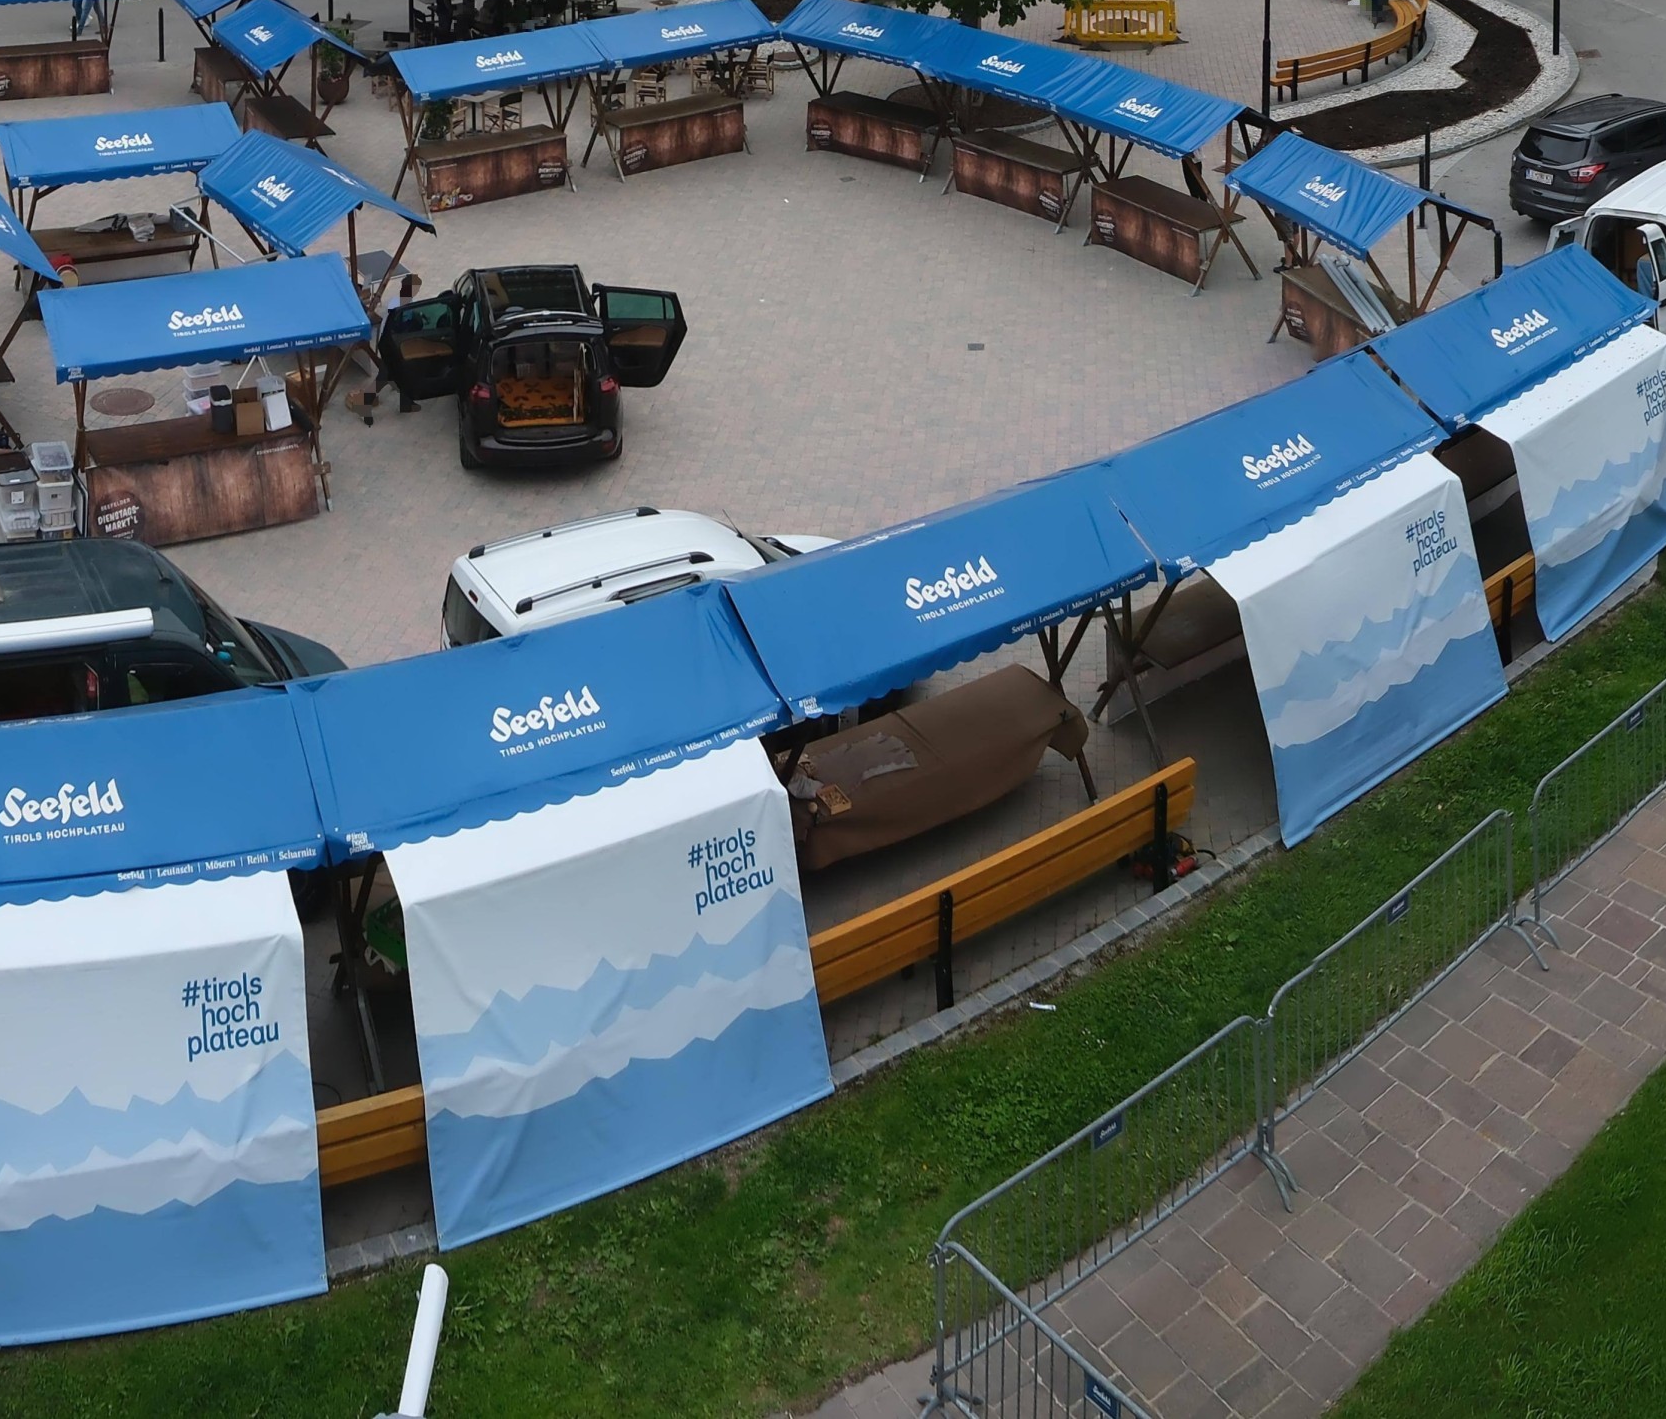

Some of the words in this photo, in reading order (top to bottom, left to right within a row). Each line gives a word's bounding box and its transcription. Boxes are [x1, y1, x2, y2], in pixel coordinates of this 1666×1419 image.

[661, 23, 705, 39] Seefeld
[476, 49, 524, 69] Seefeld
[981, 55, 1026, 73] Seefeld
[1119, 97, 1164, 118] Seefeld
[94, 132, 153, 151] Seefeld
[1305, 175, 1347, 202] Seefeld
[168, 303, 244, 330] Seefeld
[1491, 308, 1550, 349] Seefeld
[1242, 433, 1315, 480] Seefeld
[97, 505, 140, 525] DIENSTAGS-
[1405, 510, 1445, 543] #tirols
[1416, 526, 1446, 551] hoch
[1413, 536, 1458, 577] plateau
[905, 555, 998, 610] Seefeld
[916, 607, 946, 623] TIROLS
[947, 586, 1005, 614] HOCHPLATEAU
[490, 685, 601, 742] Seefeld
[499, 740, 535, 758] TIROLS
[537, 720, 607, 748] HOCHPLATEAU
[610, 761, 636, 778] Seefeld
[644, 749, 678, 768] Leutasch
[684, 738, 712, 756] Mösern
[720, 727, 740, 743] Reith
[746, 711, 779, 730] Scharnitz
[3, 831, 43, 844] TIROLS
[47, 821, 126, 840] HOCHPLATEAU
[688, 827, 756, 868] #tirols
[157, 864, 195, 877] Leutasch
[205, 857, 236, 872] Mösern
[246, 852, 270, 865] Reith
[278, 846, 318, 861] Scharnitz
[705, 846, 756, 881] hoch
[695, 866, 774, 915] plateau
[182, 972, 263, 1007] #tirols
[200, 996, 261, 1027] hoch
[187, 1022, 280, 1062] plateau
